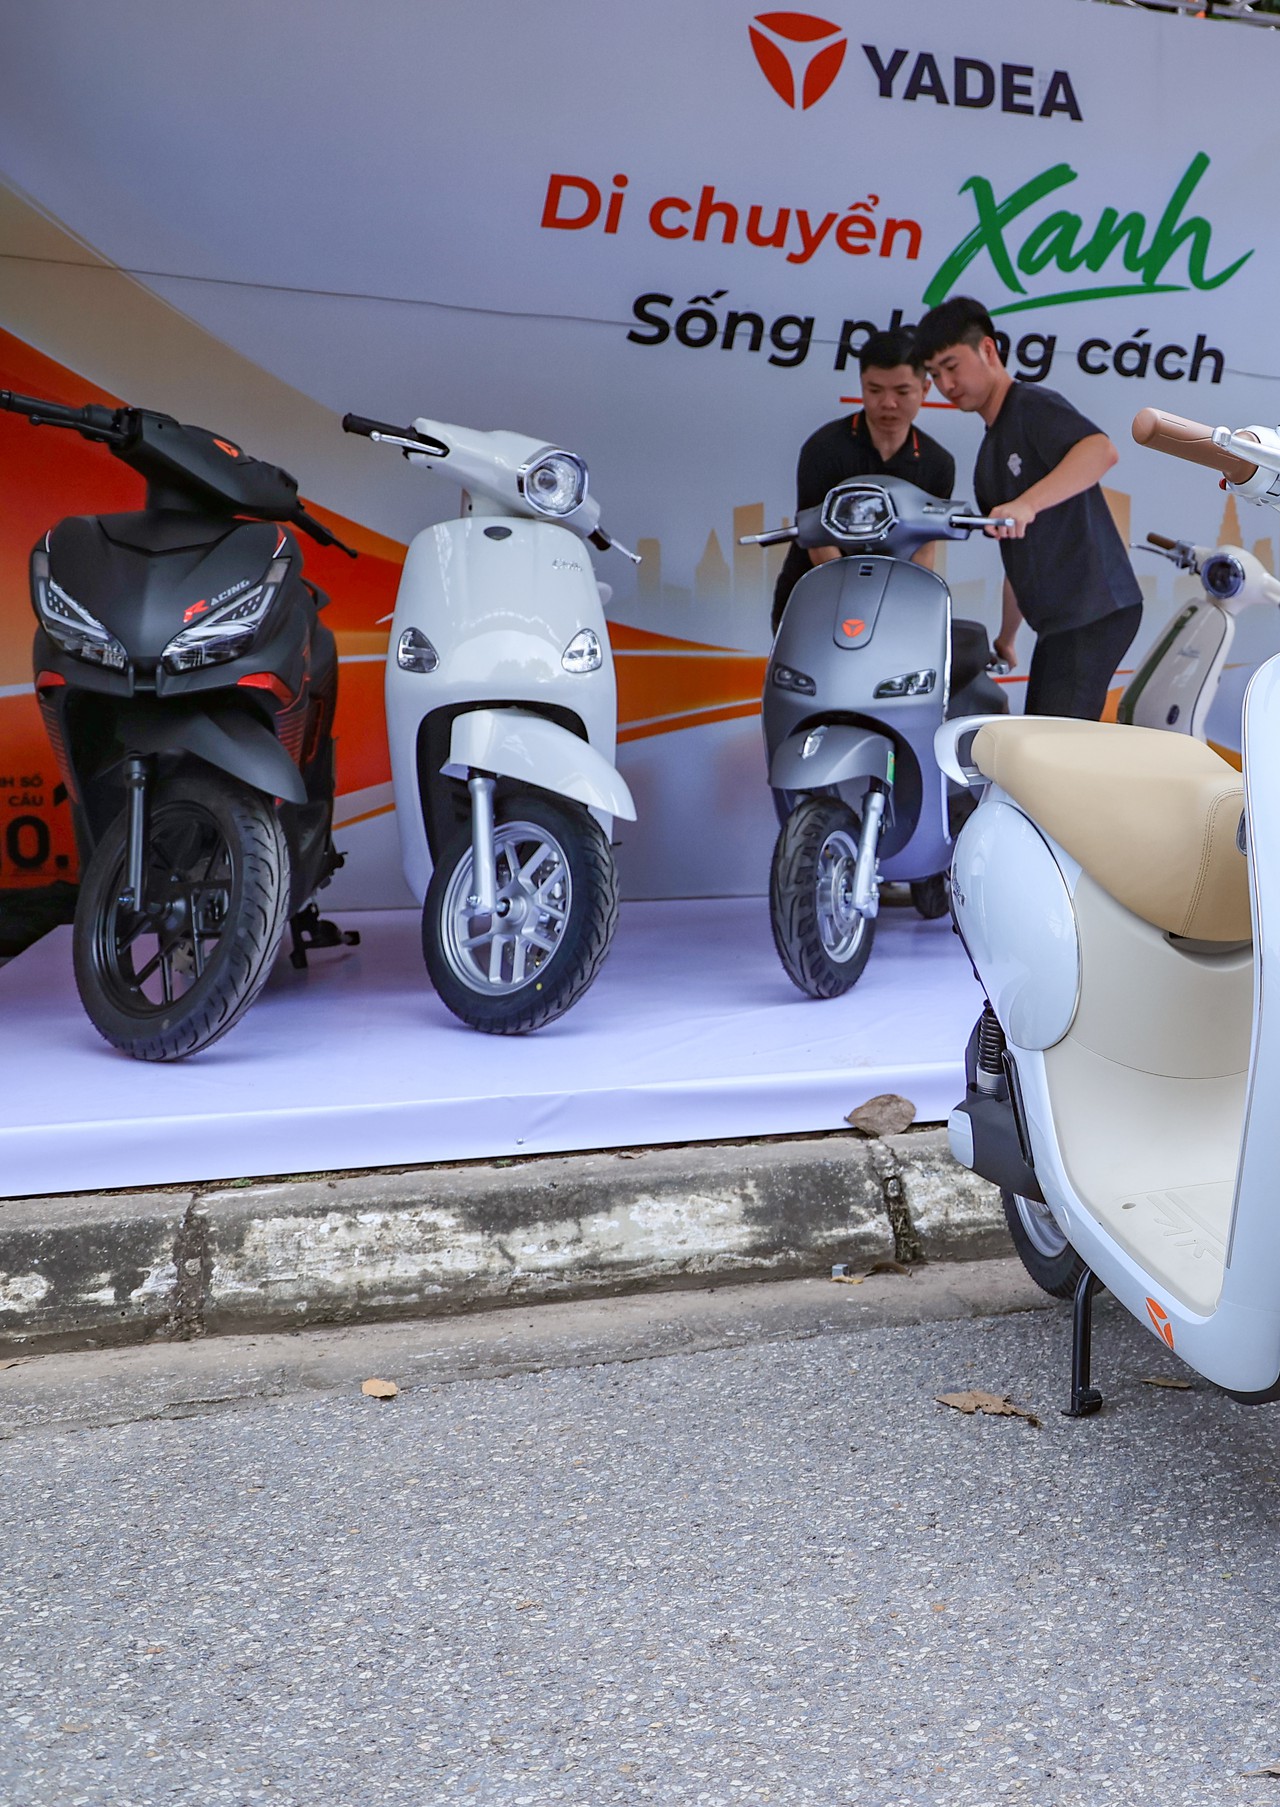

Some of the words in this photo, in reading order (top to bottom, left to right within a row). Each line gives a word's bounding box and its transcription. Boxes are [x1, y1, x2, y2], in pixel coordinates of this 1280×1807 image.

[861, 45, 1083, 121] YADEA
[540, 173, 629, 234] Di
[648, 185, 922, 264] chuyển
[922, 151, 1255, 312] Xanh
[626, 290, 815, 368] Sống
[834, 309, 1057, 382] phng
[1077, 329, 1225, 383] cách
